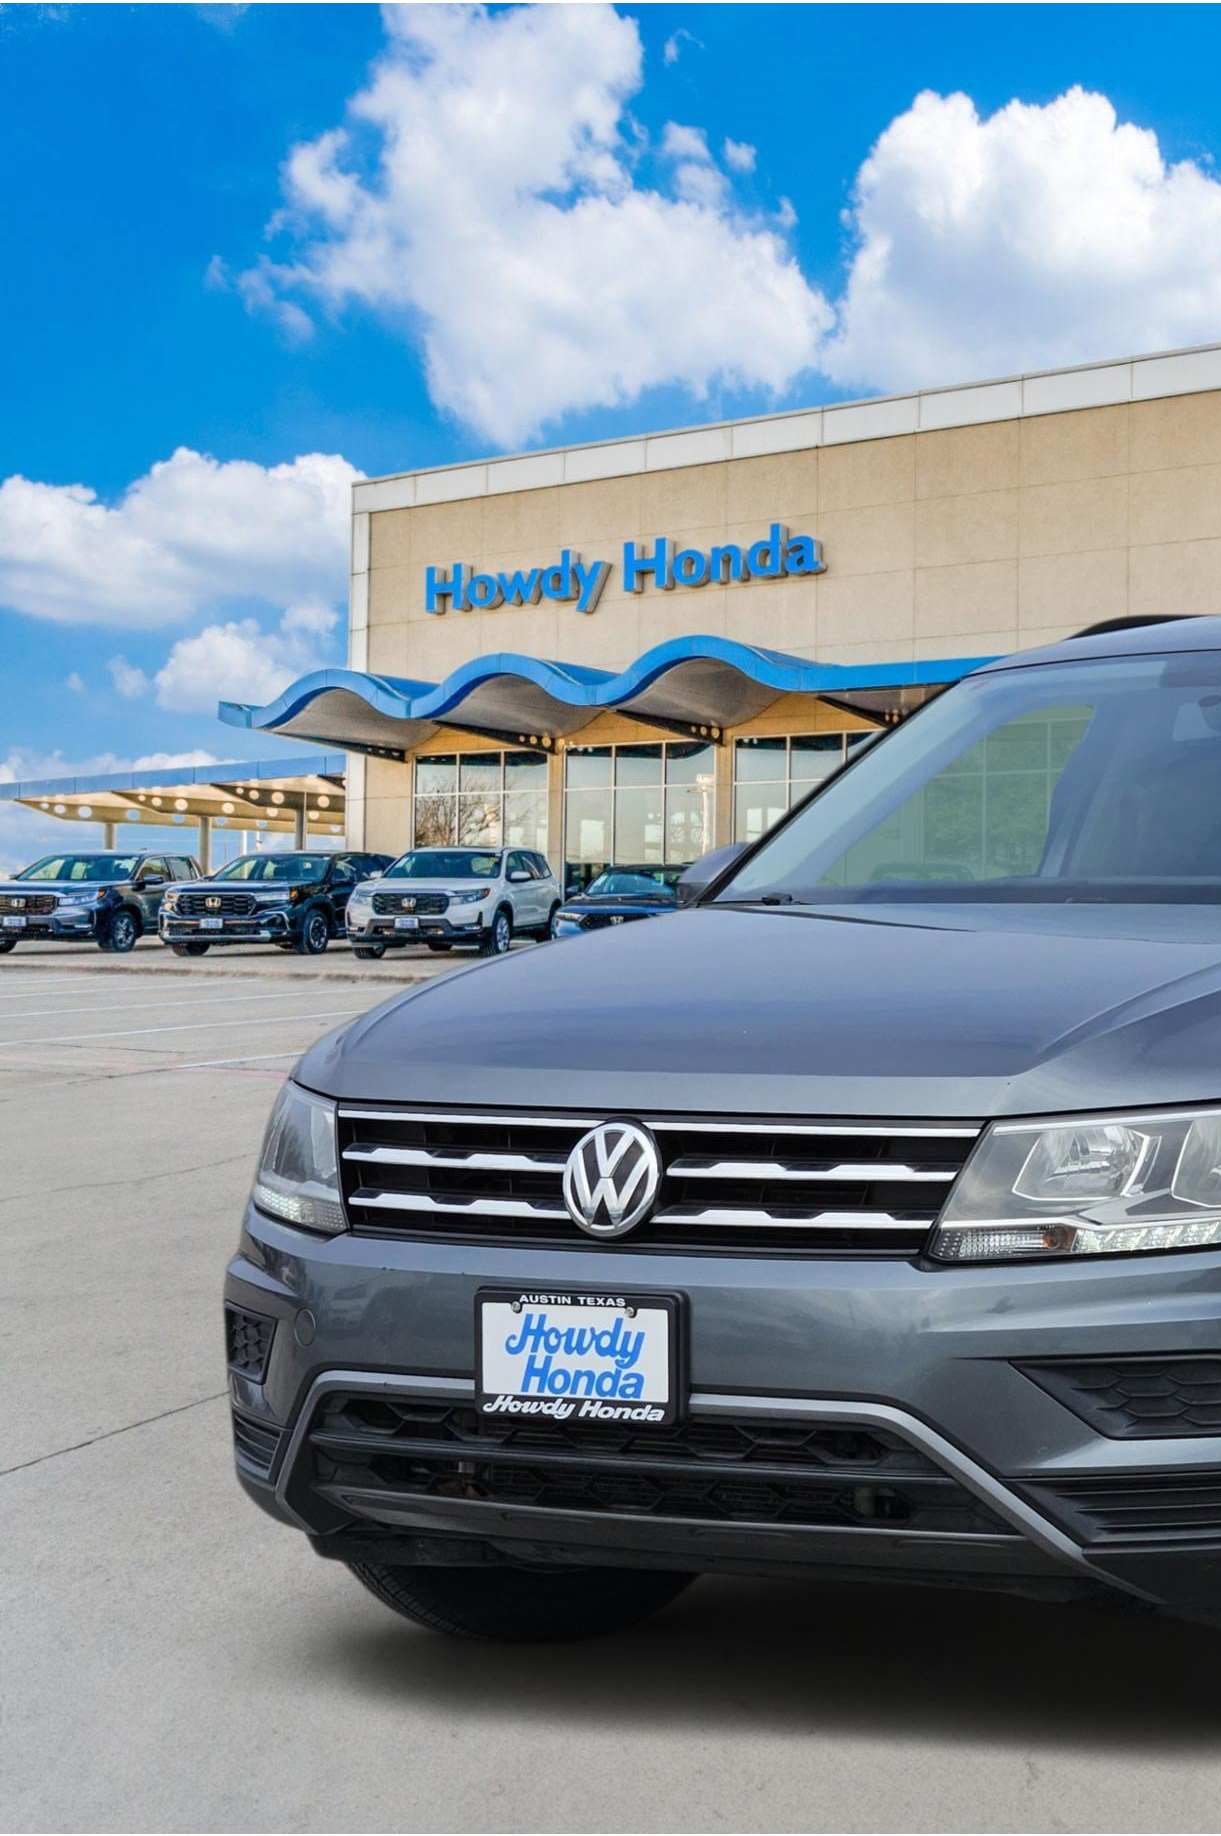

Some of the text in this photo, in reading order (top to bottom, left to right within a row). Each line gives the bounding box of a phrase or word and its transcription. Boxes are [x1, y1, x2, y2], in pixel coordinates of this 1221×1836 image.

[425, 522, 826, 615] Howdy Honda
[519, 1294, 627, 1307] AUSTIN TEXAS
[505, 1313, 645, 1369] Howdy
[520, 1355, 645, 1400] Honda
[483, 1394, 666, 1422] Howdy Honda
